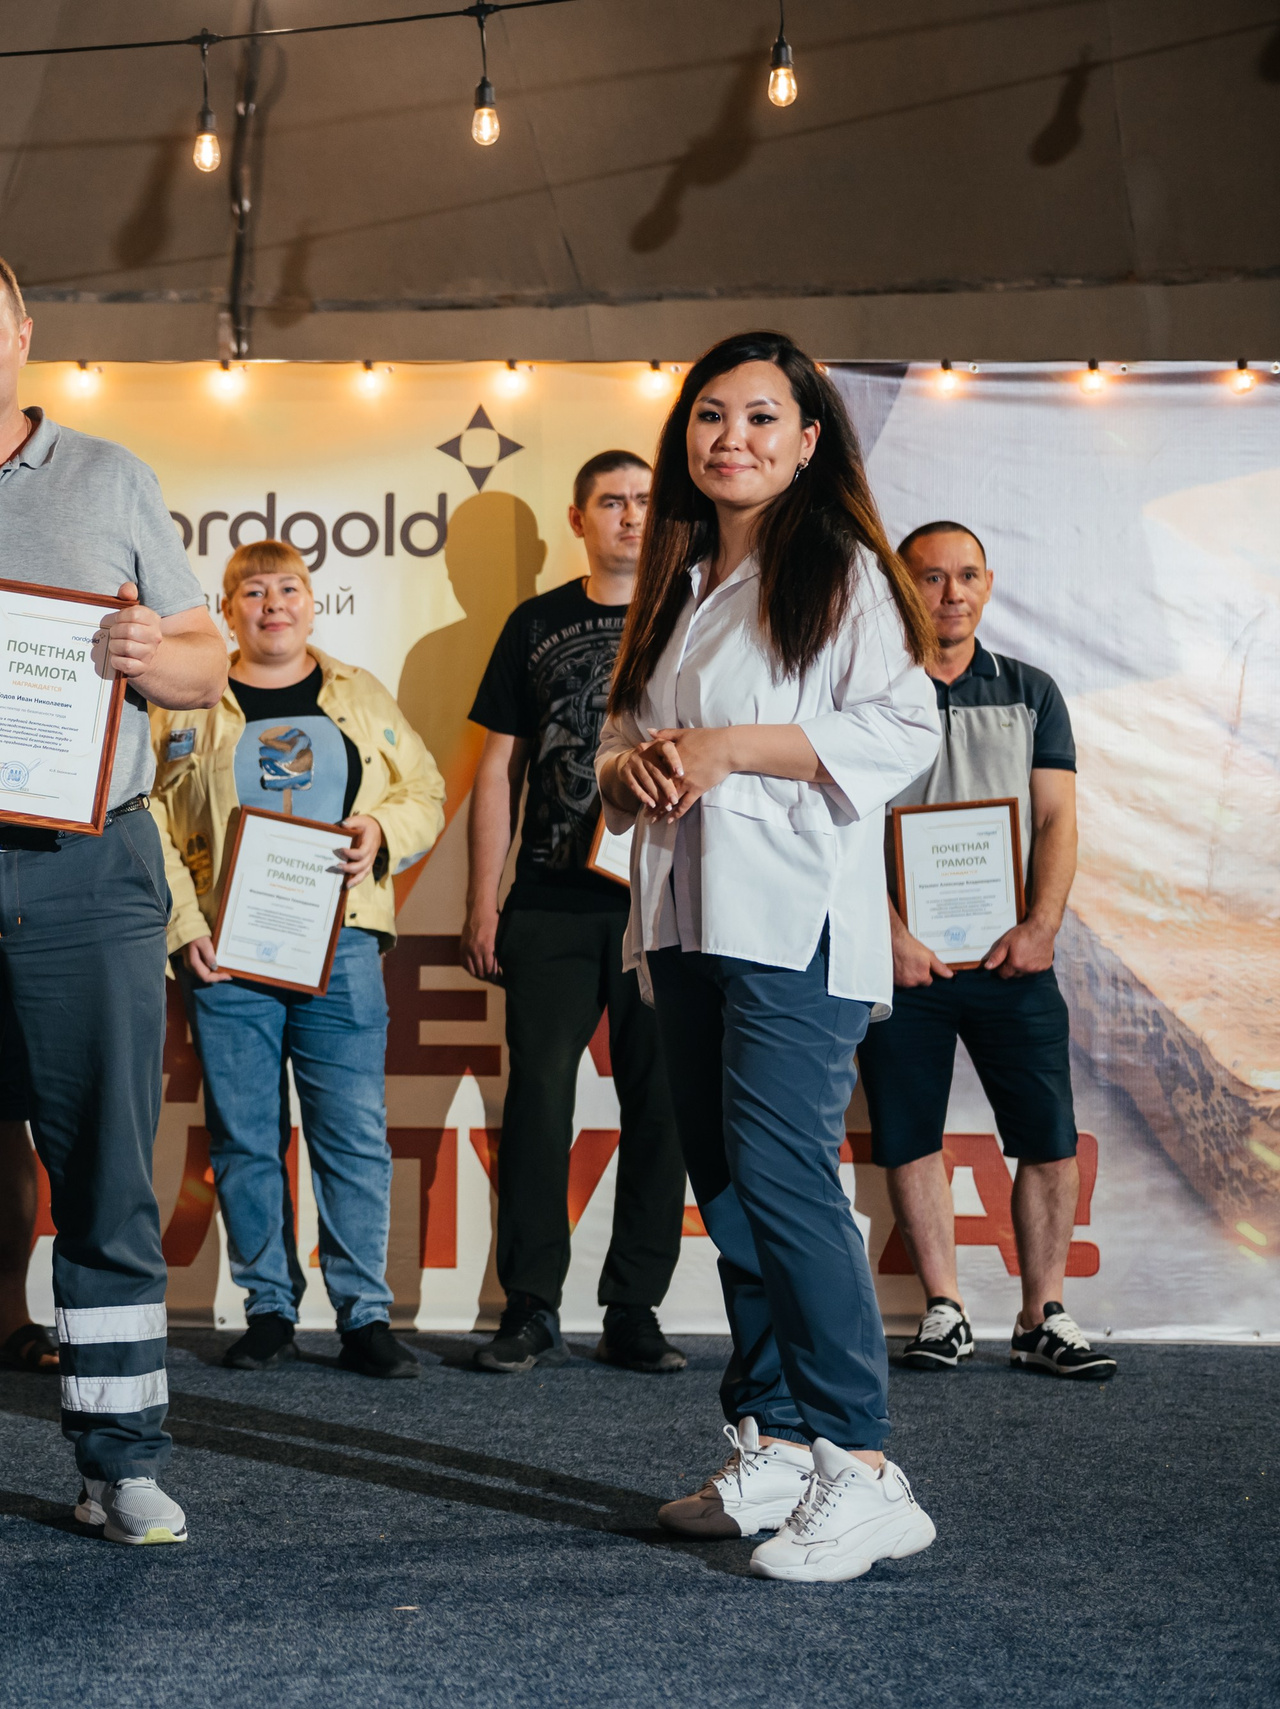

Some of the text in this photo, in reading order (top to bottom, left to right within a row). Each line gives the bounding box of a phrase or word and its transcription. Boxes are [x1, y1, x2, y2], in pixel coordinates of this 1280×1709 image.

[170, 492, 447, 573] rdgold
[6, 639, 86, 663] ПОЧЕТНАЯ
[8, 660, 77, 682] ГРАМОТА
[12, 679, 62, 693] НАГРАЖДАЕТСЯ
[16, 694, 33, 703] Иван
[34, 697, 73, 709] Николаевич
[931, 841, 990, 855] ПОЧЕТНАЯ
[266, 853, 324, 874] ПОЧЕТНАЯ
[936, 856, 987, 868] ГРАМОТА
[266, 868, 317, 888] ГРАМОТА
